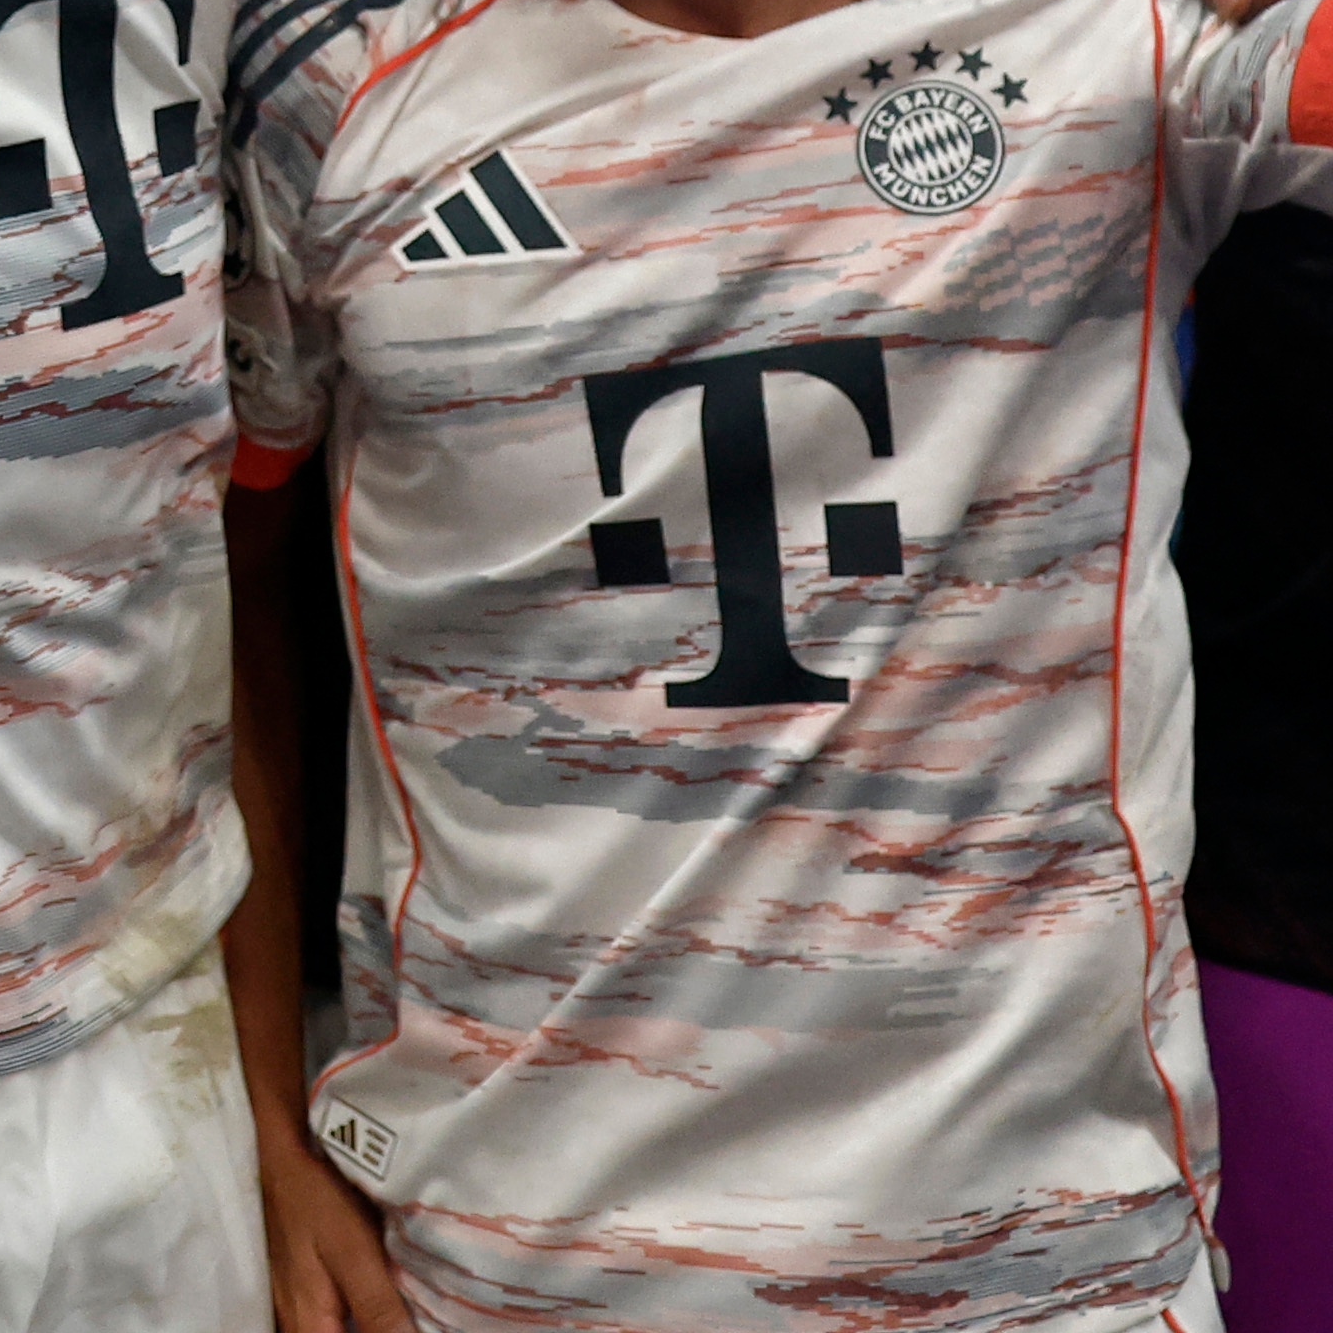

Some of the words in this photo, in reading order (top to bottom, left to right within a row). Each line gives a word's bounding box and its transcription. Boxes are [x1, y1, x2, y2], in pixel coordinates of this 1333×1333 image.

[869, 110, 896, 142] FC
[894, 89, 990, 134] BAYERN
[583, 337, 895, 708] T
